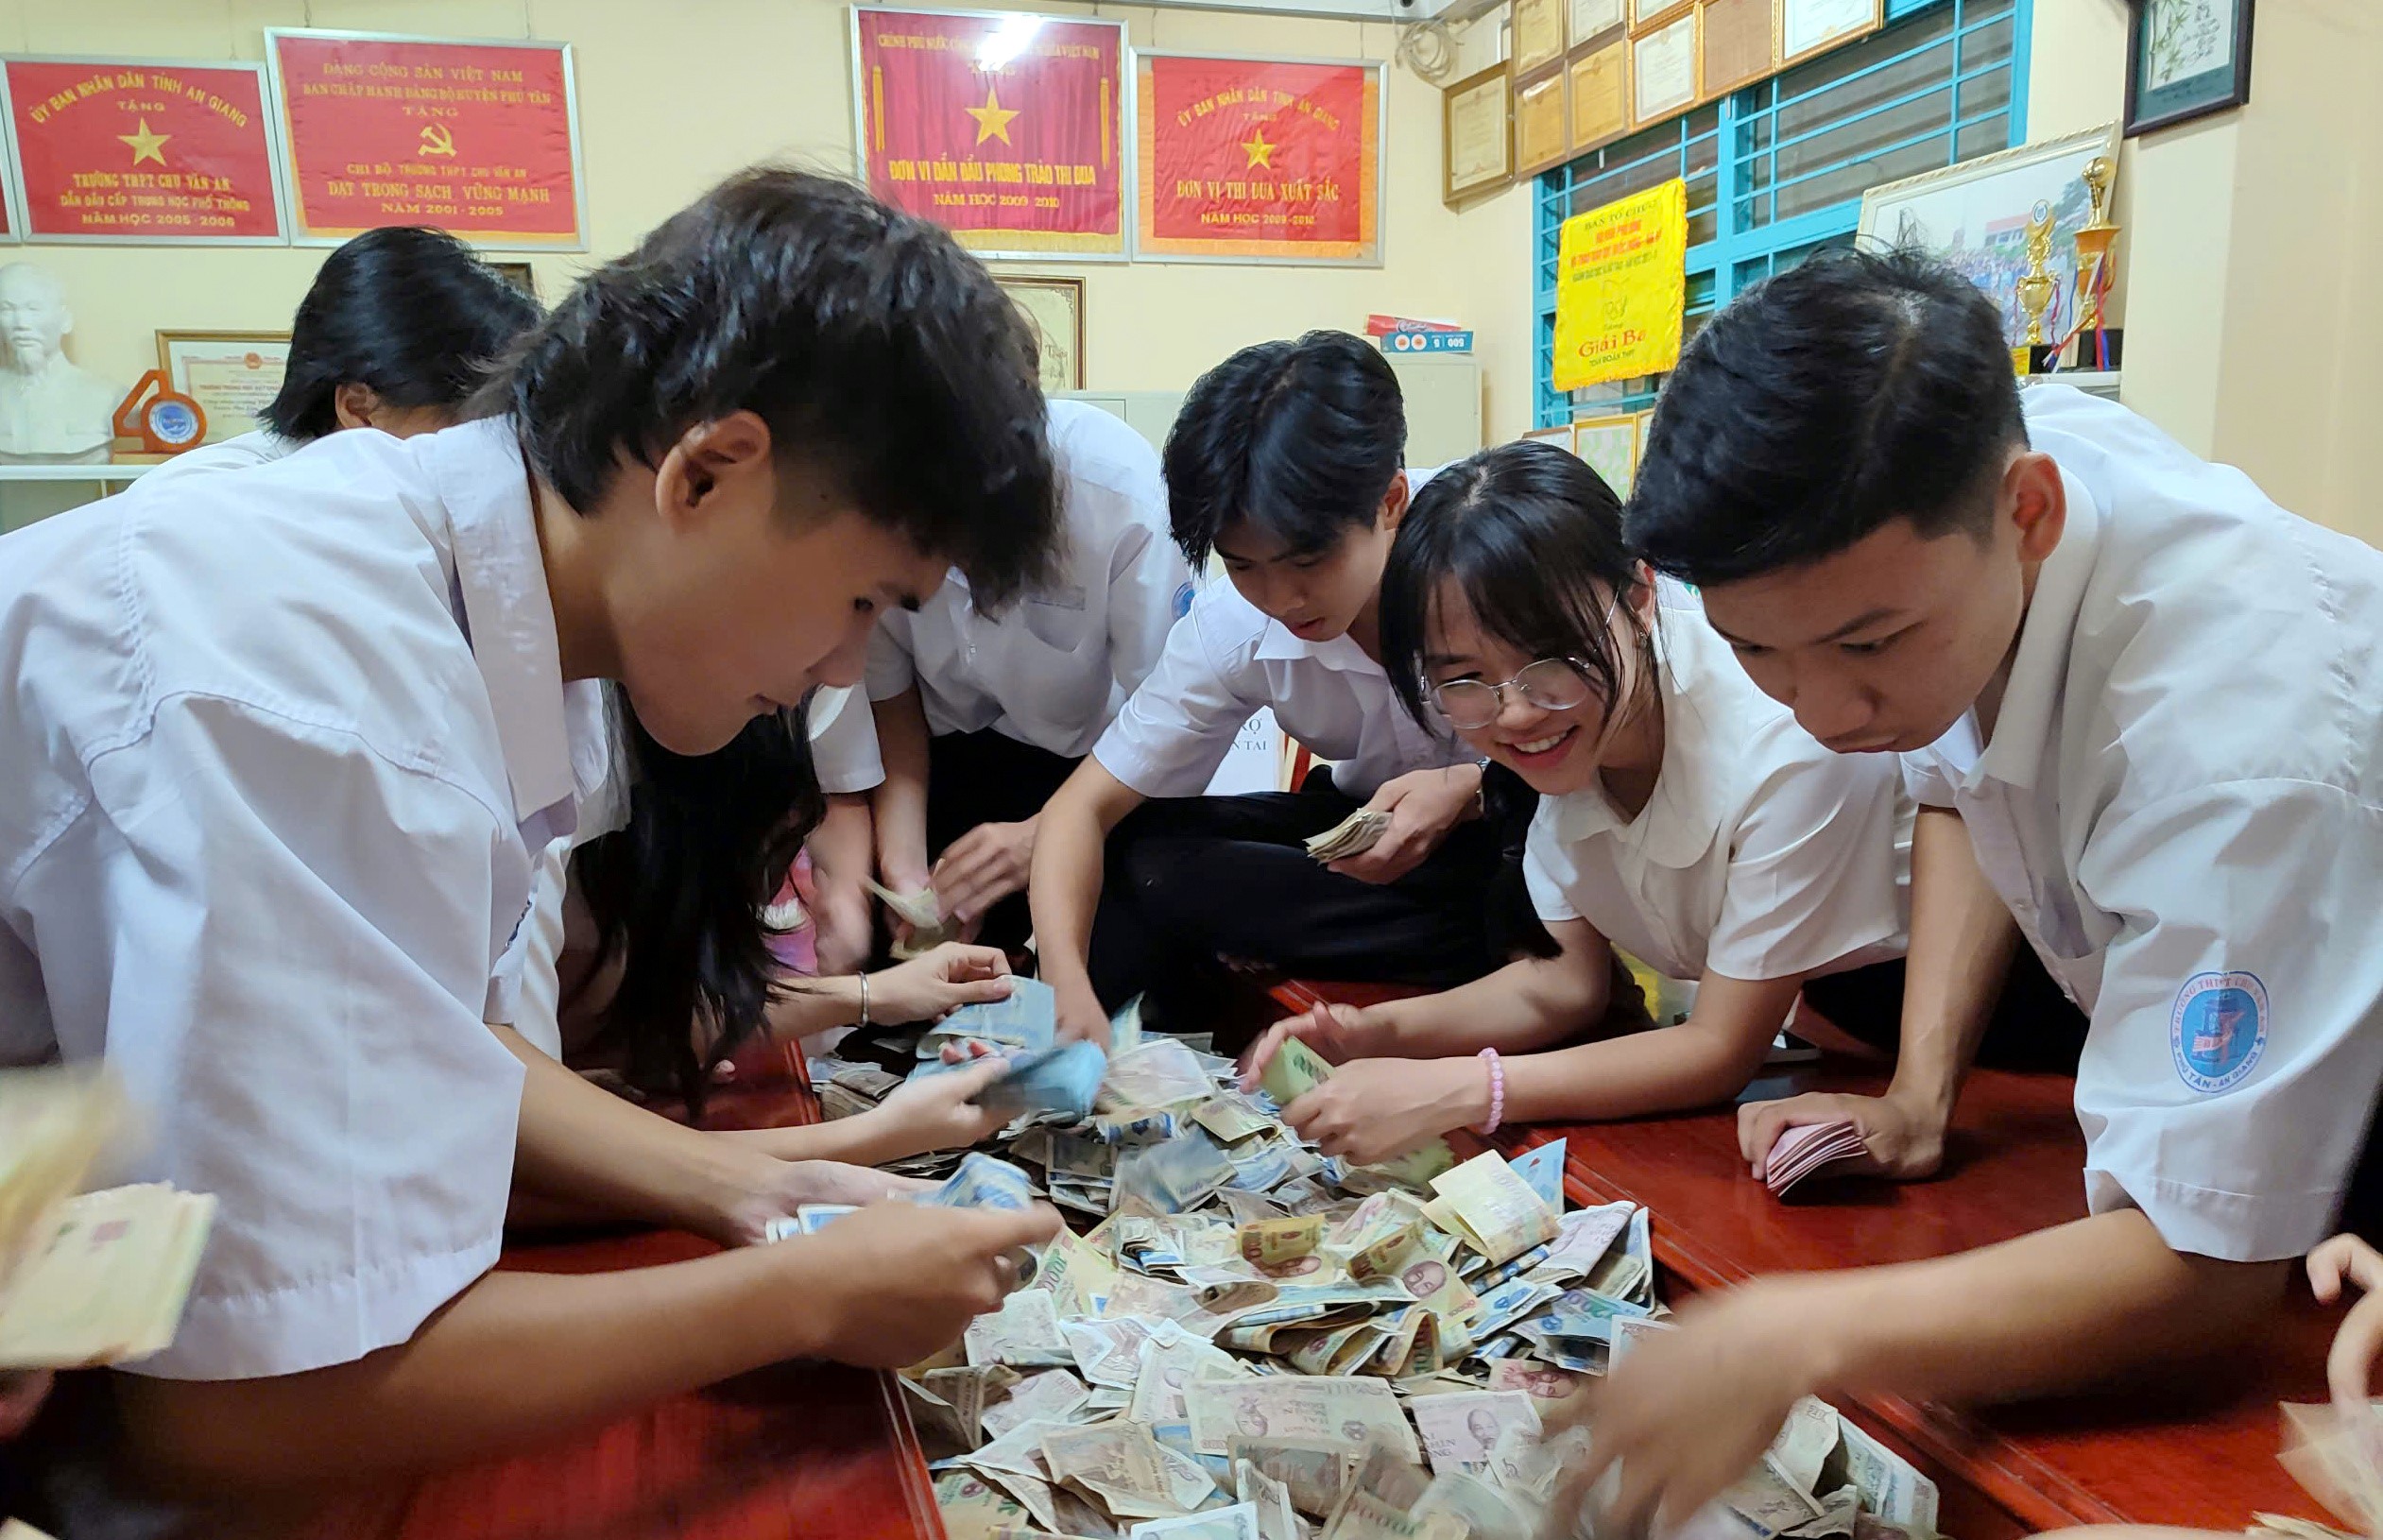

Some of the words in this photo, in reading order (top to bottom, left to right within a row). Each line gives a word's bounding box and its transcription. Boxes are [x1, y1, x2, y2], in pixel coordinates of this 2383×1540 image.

[450, 65, 485, 83] VIỆT
[491, 70, 523, 82] NAM
[49, 88, 77, 111] BAN
[77, 74, 114, 98] NHÂN
[117, 71, 146, 89] DÂN
[151, 72, 182, 94] TỈNH
[186, 85, 206, 105] AN
[209, 95, 248, 128] GIANG
[1193, 97, 1214, 116] BAN
[158, 174, 181, 188] CHU
[1054, 164, 1072, 185] THI
[361, 180, 410, 198] TRONG
[1226, 180, 1246, 200] THI
[1279, 178, 1312, 202] XUẤT
[425, 203, 458, 215] 2001
[119, 214, 152, 227] HỌC
